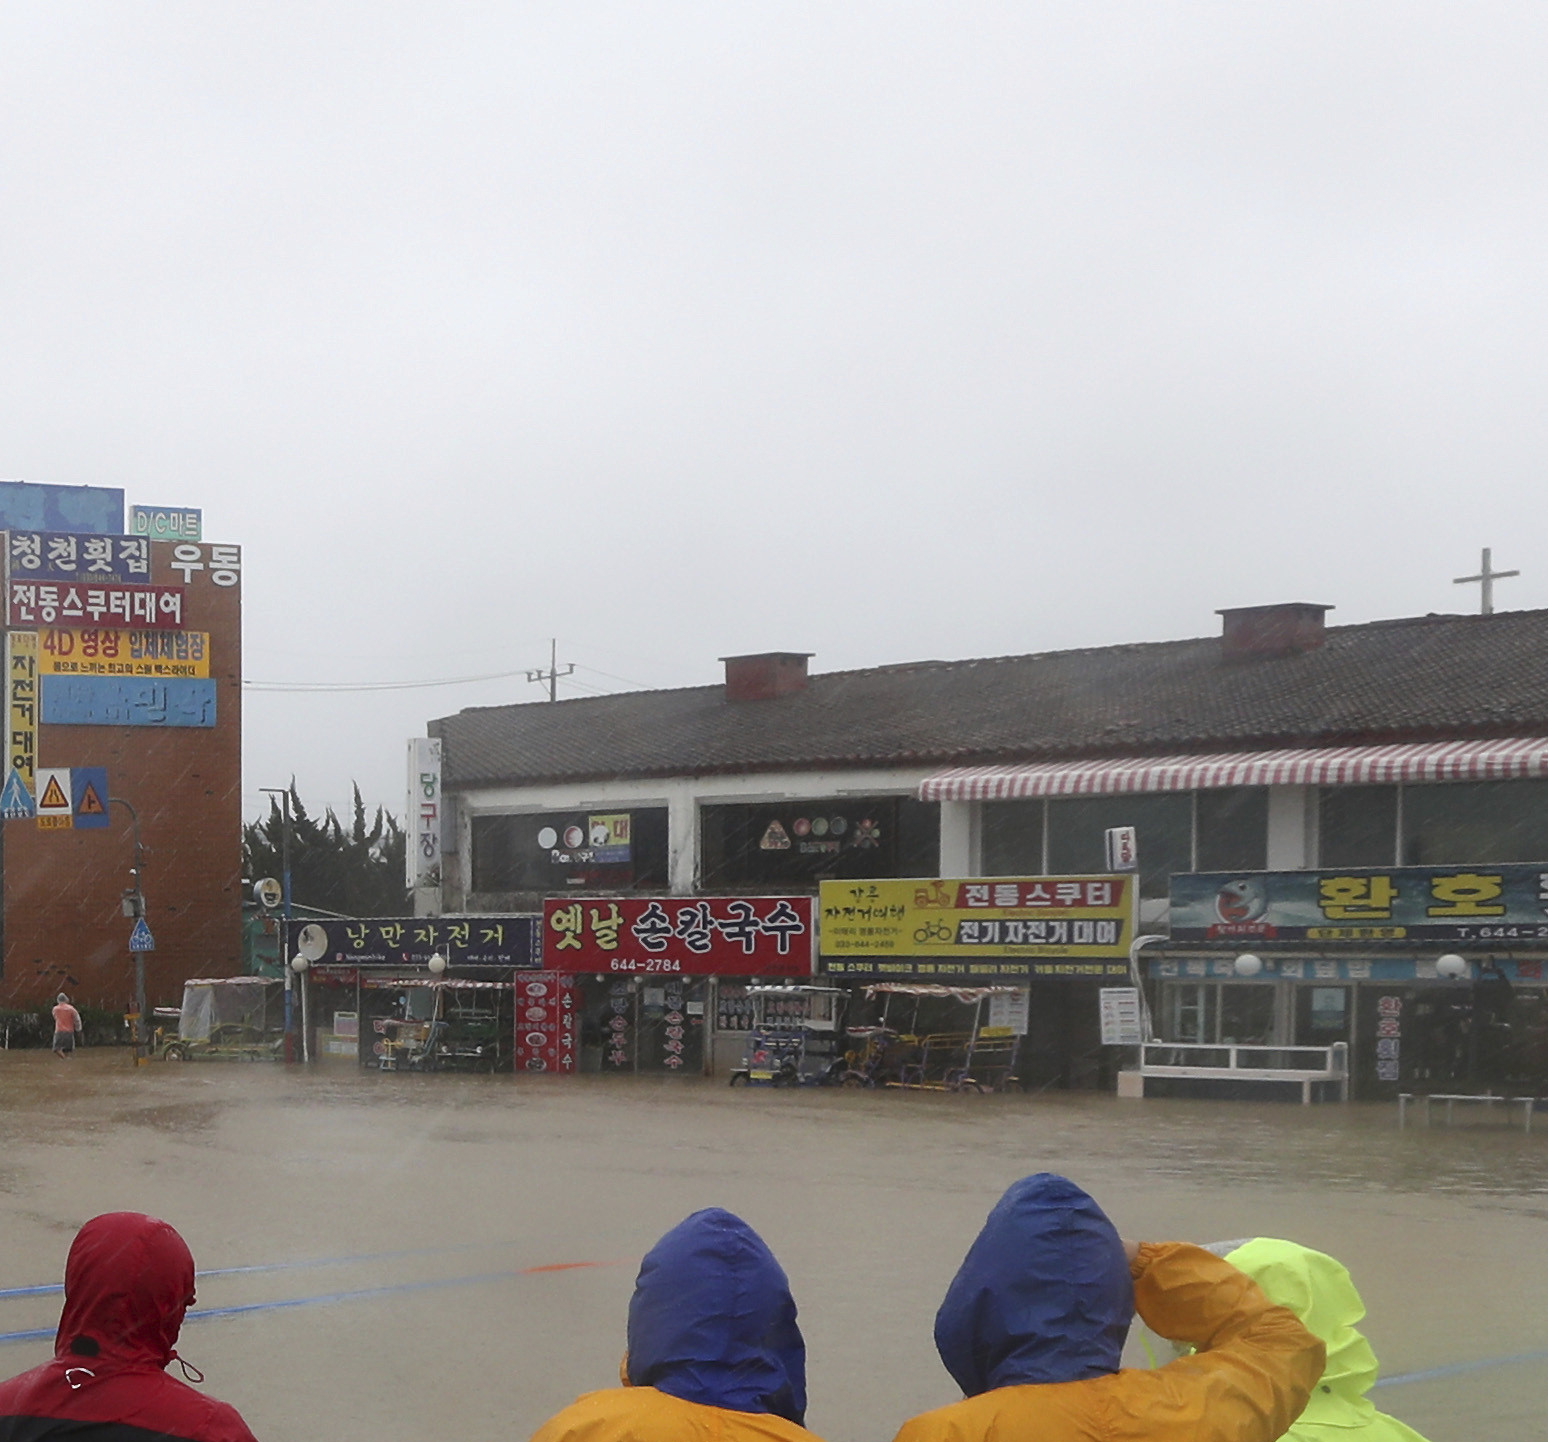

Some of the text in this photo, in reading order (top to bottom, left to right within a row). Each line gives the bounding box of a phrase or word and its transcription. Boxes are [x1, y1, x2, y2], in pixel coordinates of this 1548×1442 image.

[136, 511, 199, 537] D/C마트
[11, 535, 149, 575] 청천횟집
[170, 544, 241, 587] 우동
[11, 584, 182, 624] 전동스쿠터대여
[43, 630, 75, 657] 4D
[80, 630, 121, 658] 영상
[12, 655, 36, 726] 자전거
[12, 731, 34, 778] 대여
[420, 772, 438, 858] 당구장
[1317, 873, 1506, 921] 환호
[346, 922, 505, 949] 낭만자전거
[550, 900, 805, 955] 옛날 손칼국수
[960, 921, 1116, 944] 전기 자전거 대여
[610, 958, 681, 971] 644-2784
